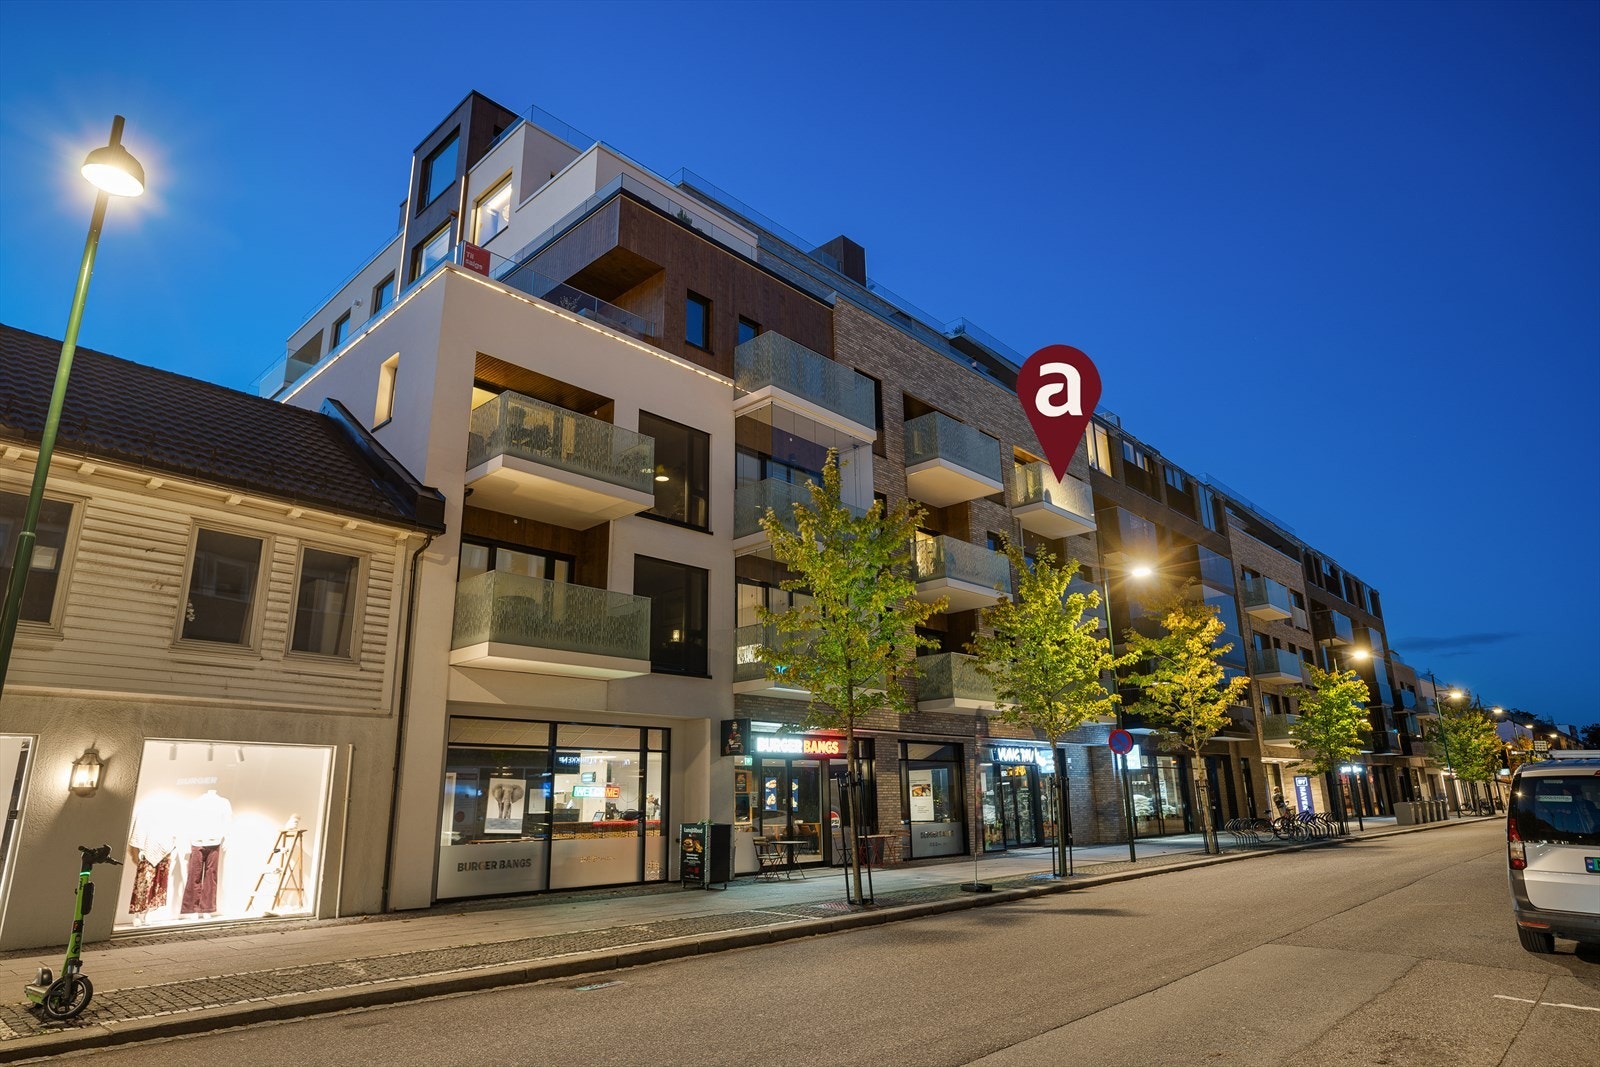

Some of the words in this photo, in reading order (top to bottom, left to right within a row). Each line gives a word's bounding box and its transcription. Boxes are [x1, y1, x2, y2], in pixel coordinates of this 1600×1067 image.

[757, 737, 802, 753] BURGER
[803, 739, 839, 754] BANGS
[457, 860, 497, 872] BURGER
[499, 858, 532, 869] BANGS
